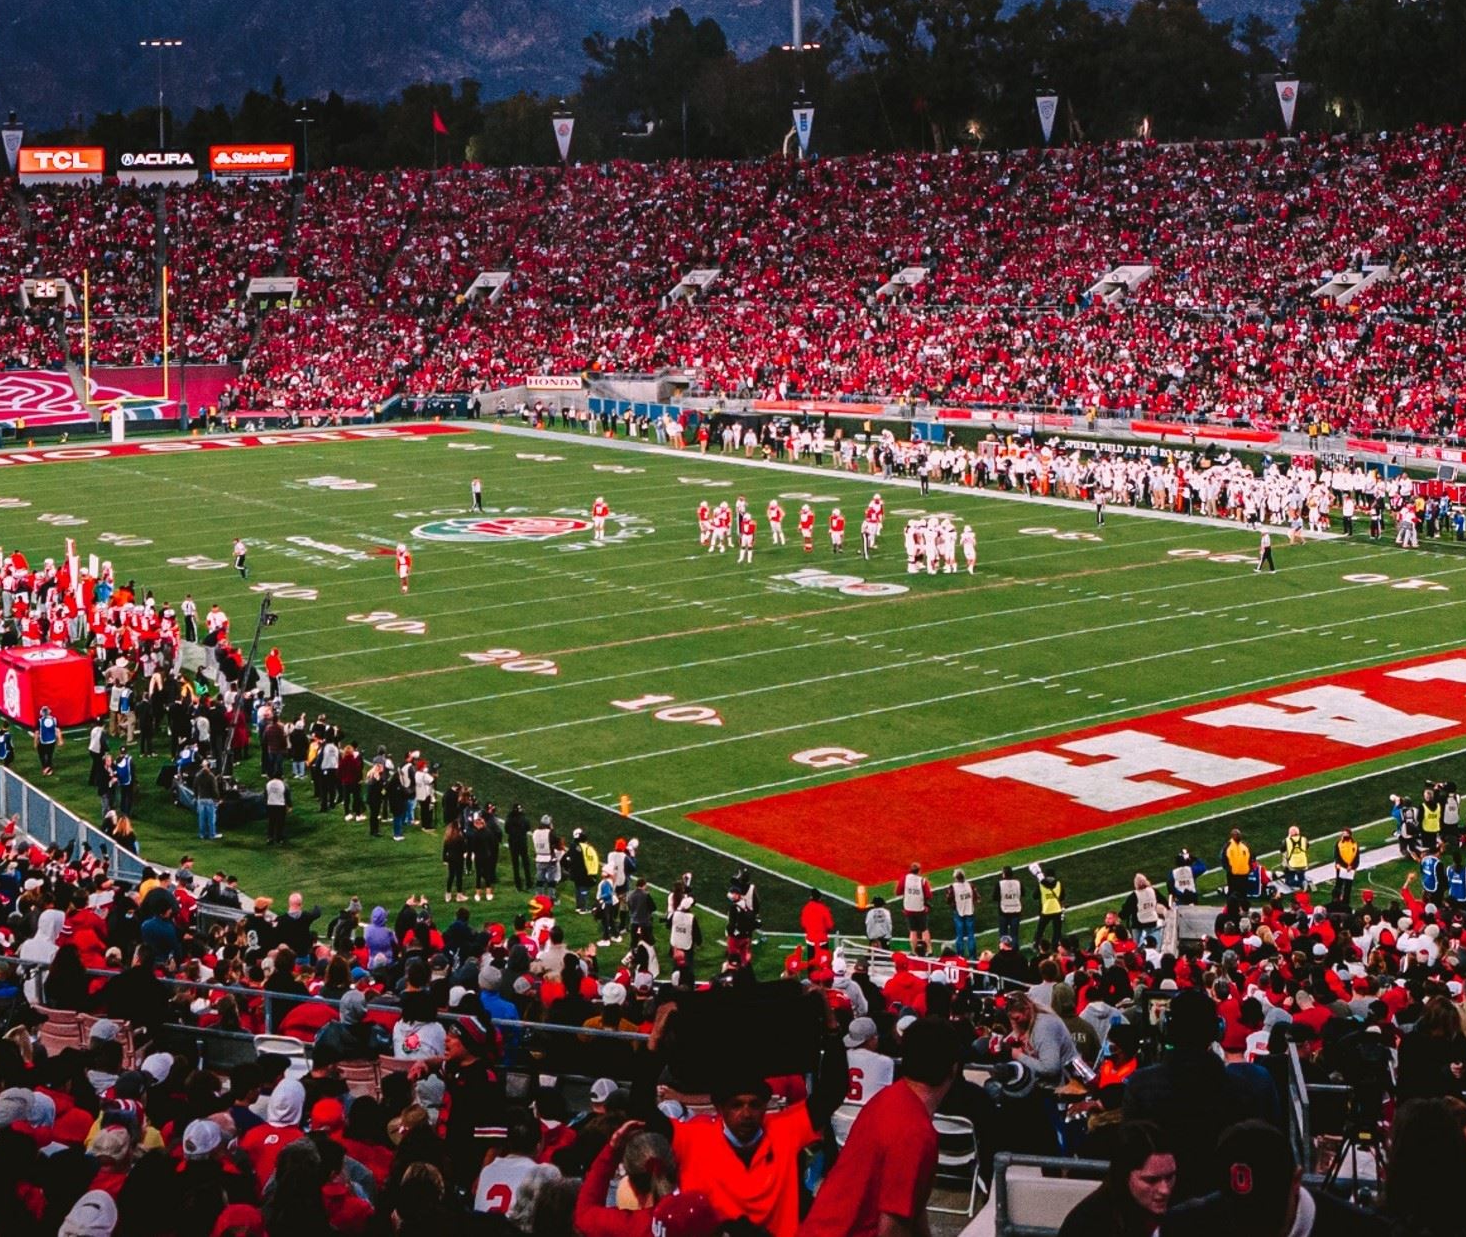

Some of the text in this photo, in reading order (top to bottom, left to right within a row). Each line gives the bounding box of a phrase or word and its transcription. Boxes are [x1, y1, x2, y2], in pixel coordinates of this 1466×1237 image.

[34, 152, 89, 169] TCL
[133, 153, 194, 165] ACURA
[528, 378, 580, 387] HONDA
[139, 428, 399, 451] STATE
[1100, 443, 1124, 453] FIELD
[1139, 447, 1158, 456] THE
[346, 612, 426, 631] 30
[460, 649, 555, 672] 20
[610, 694, 717, 722] 10
[790, 747, 869, 768] G
[945, 965, 960, 984] 10
